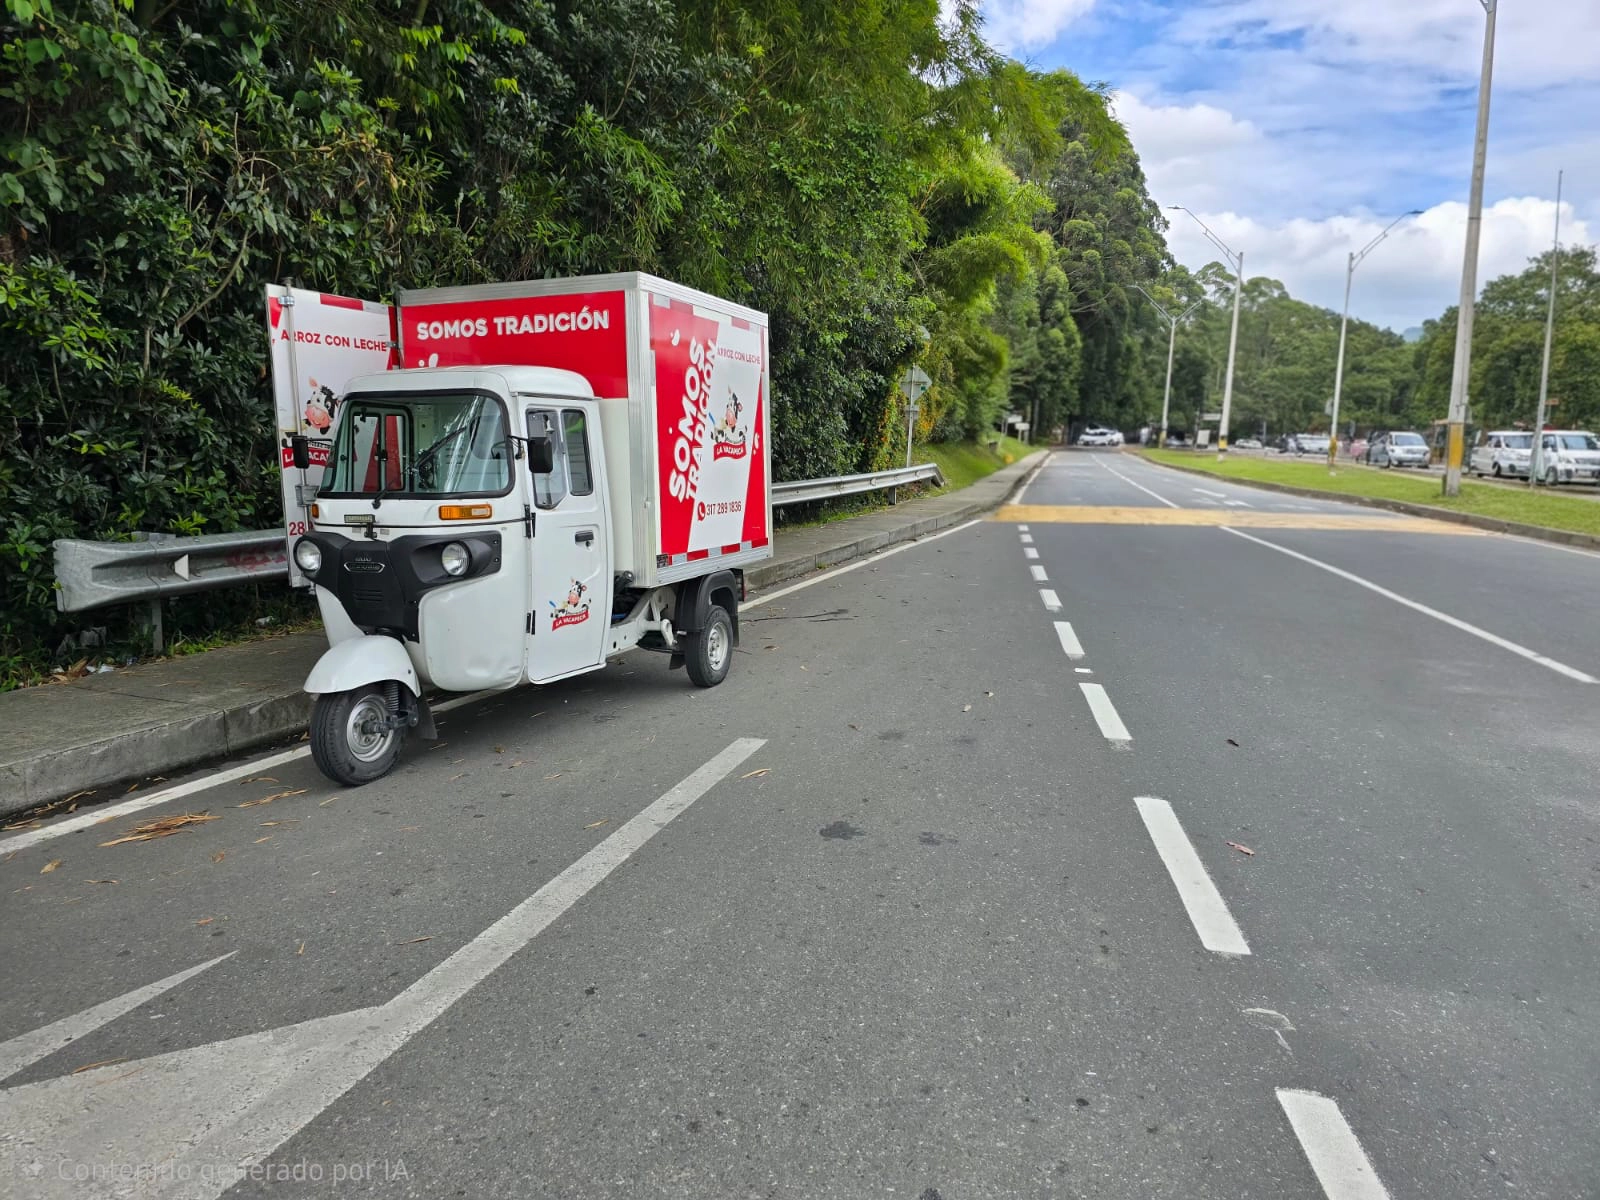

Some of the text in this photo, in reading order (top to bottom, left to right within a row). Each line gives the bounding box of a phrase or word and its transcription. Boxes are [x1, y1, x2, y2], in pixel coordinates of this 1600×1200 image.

[417, 306, 610, 340] SOMOS TRADICIÓN
[325, 335, 350, 347] CON
[354, 338, 387, 351] LECHE
[669, 336, 704, 503] SOMOS
[707, 504, 716, 516] 317
